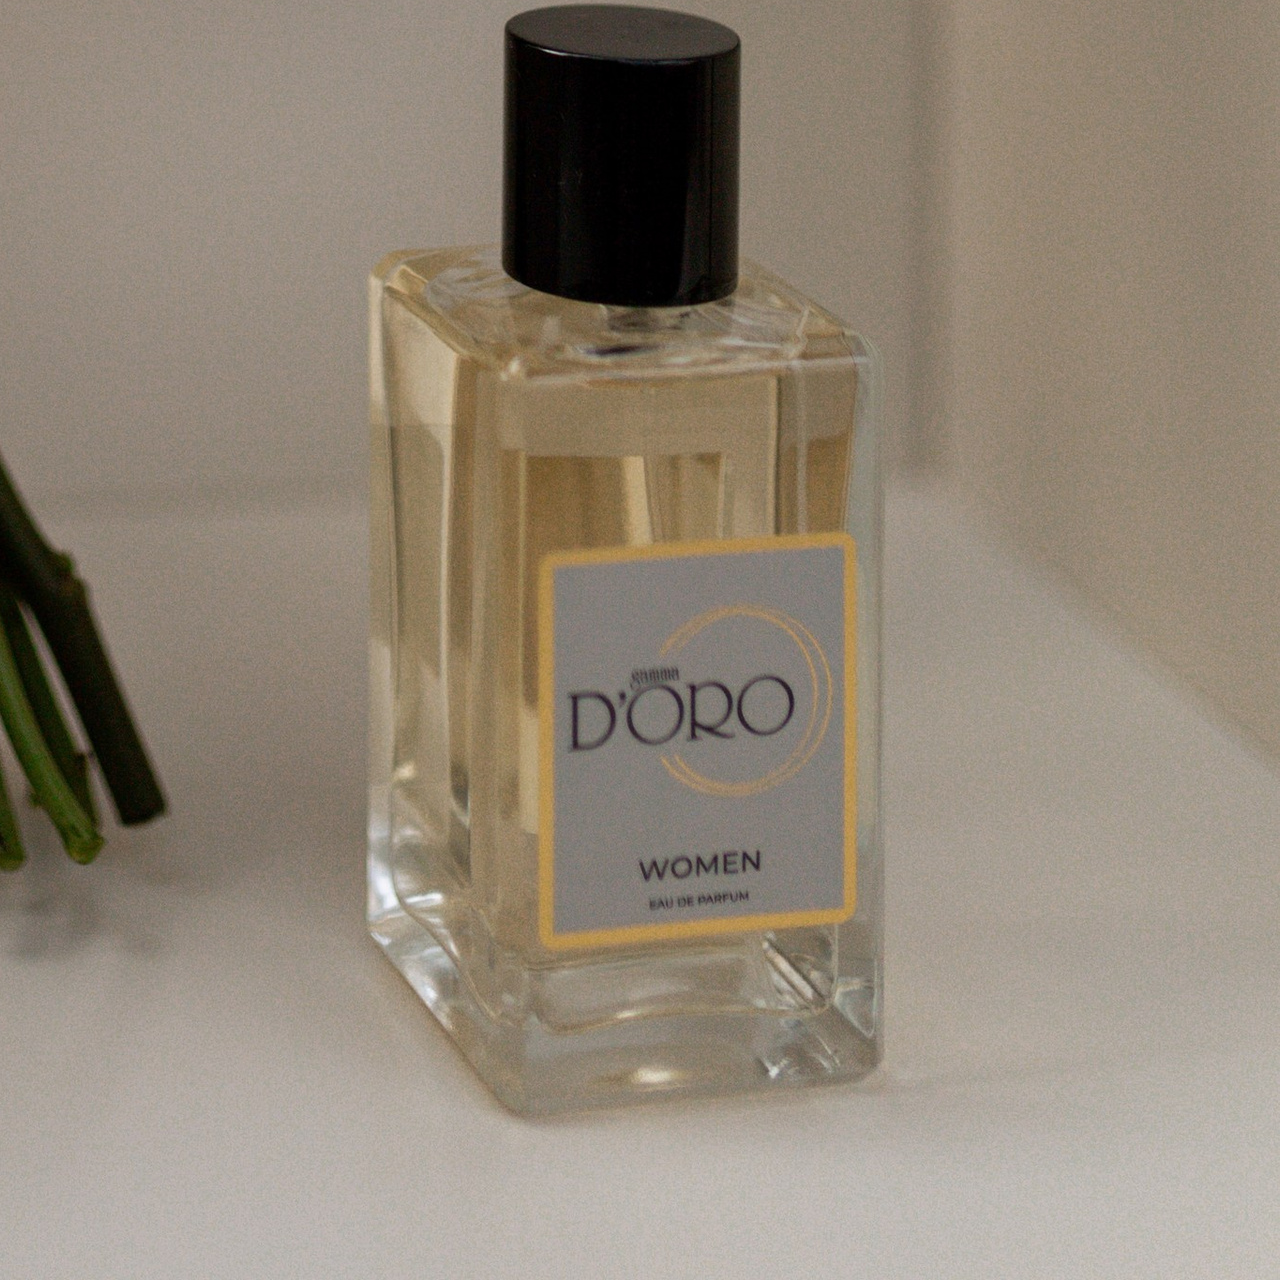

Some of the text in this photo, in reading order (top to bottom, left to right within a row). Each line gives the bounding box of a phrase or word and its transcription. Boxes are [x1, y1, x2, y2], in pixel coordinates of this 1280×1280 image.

[639, 850, 761, 881] WOMEN
[649, 890, 750, 911] EAU DE PARFUM
